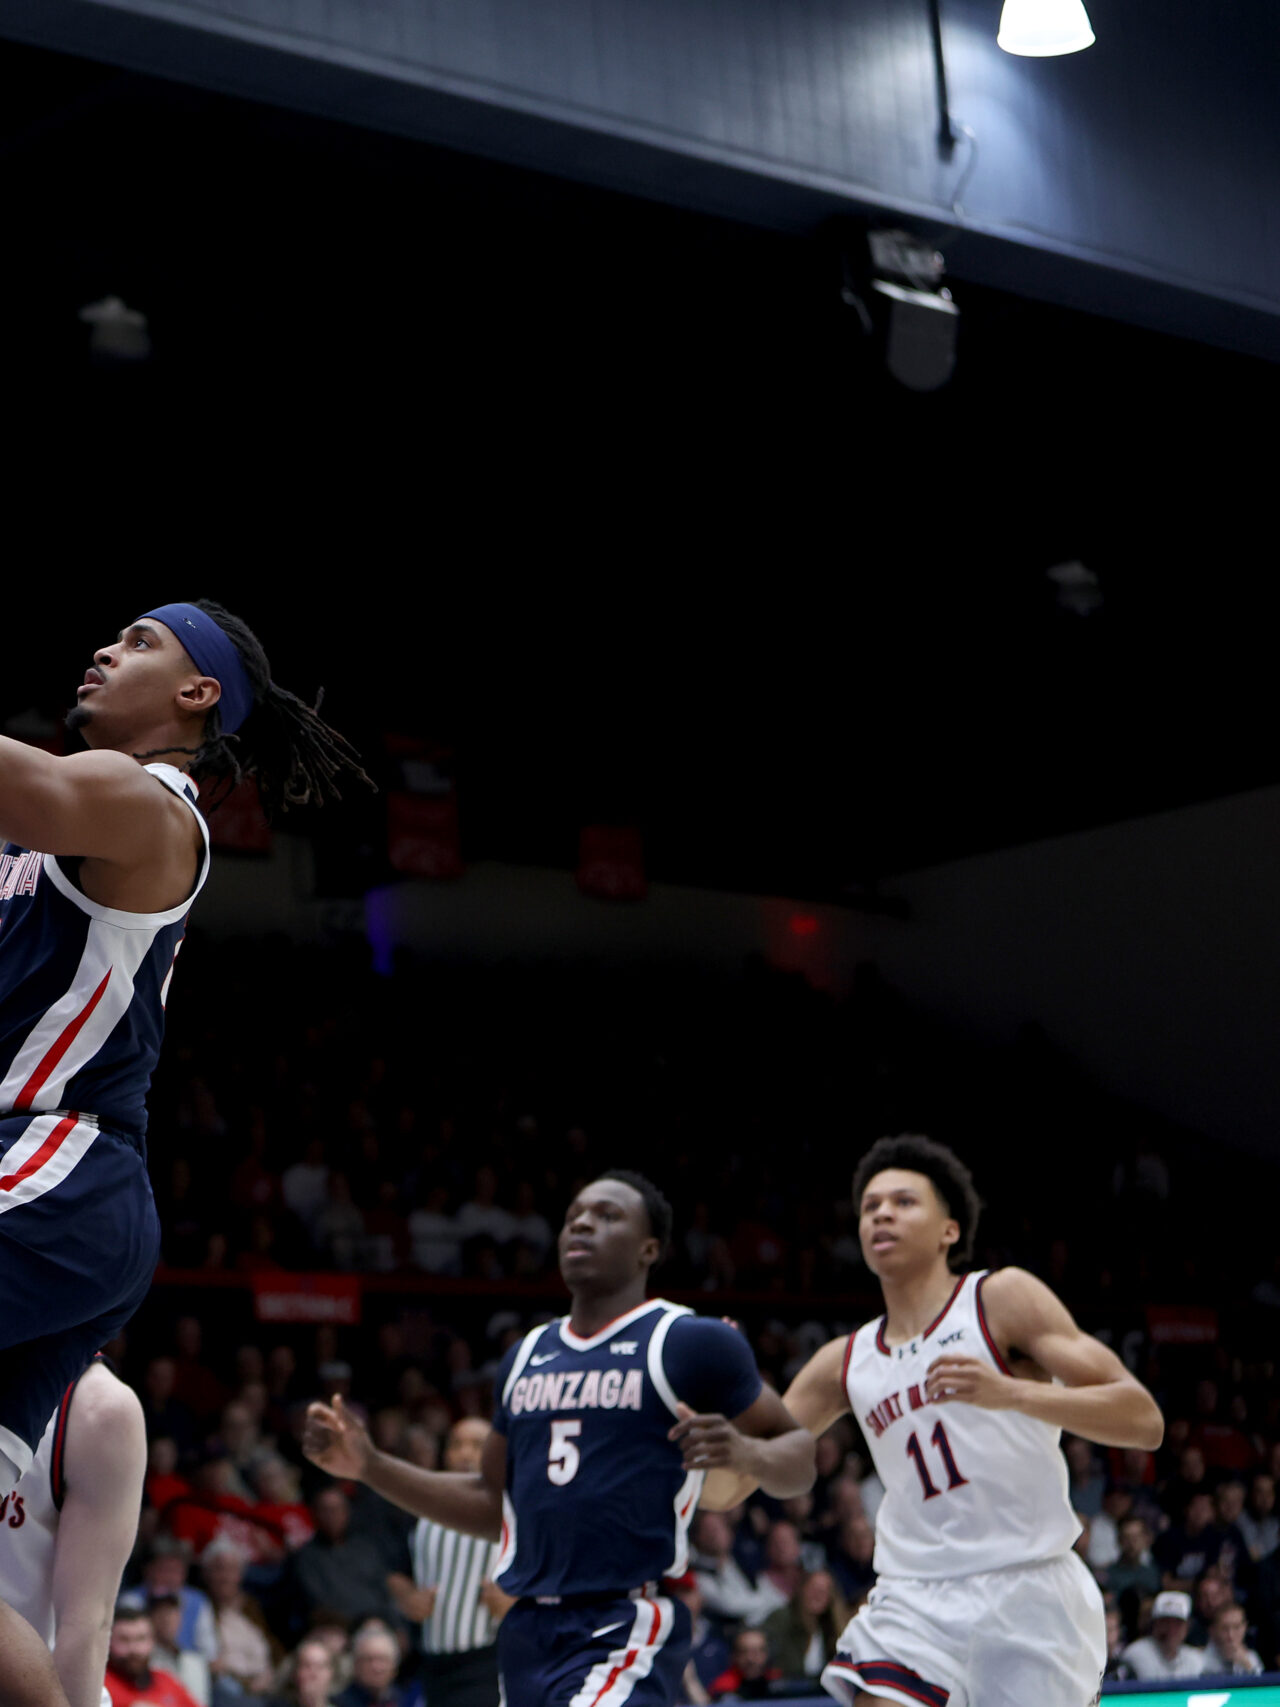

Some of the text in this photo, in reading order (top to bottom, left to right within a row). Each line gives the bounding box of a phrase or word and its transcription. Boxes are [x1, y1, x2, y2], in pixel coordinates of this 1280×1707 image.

[510, 1368, 643, 1416] GONZAGA
[546, 1419, 582, 1487] 5
[906, 1420, 970, 1501] 11
